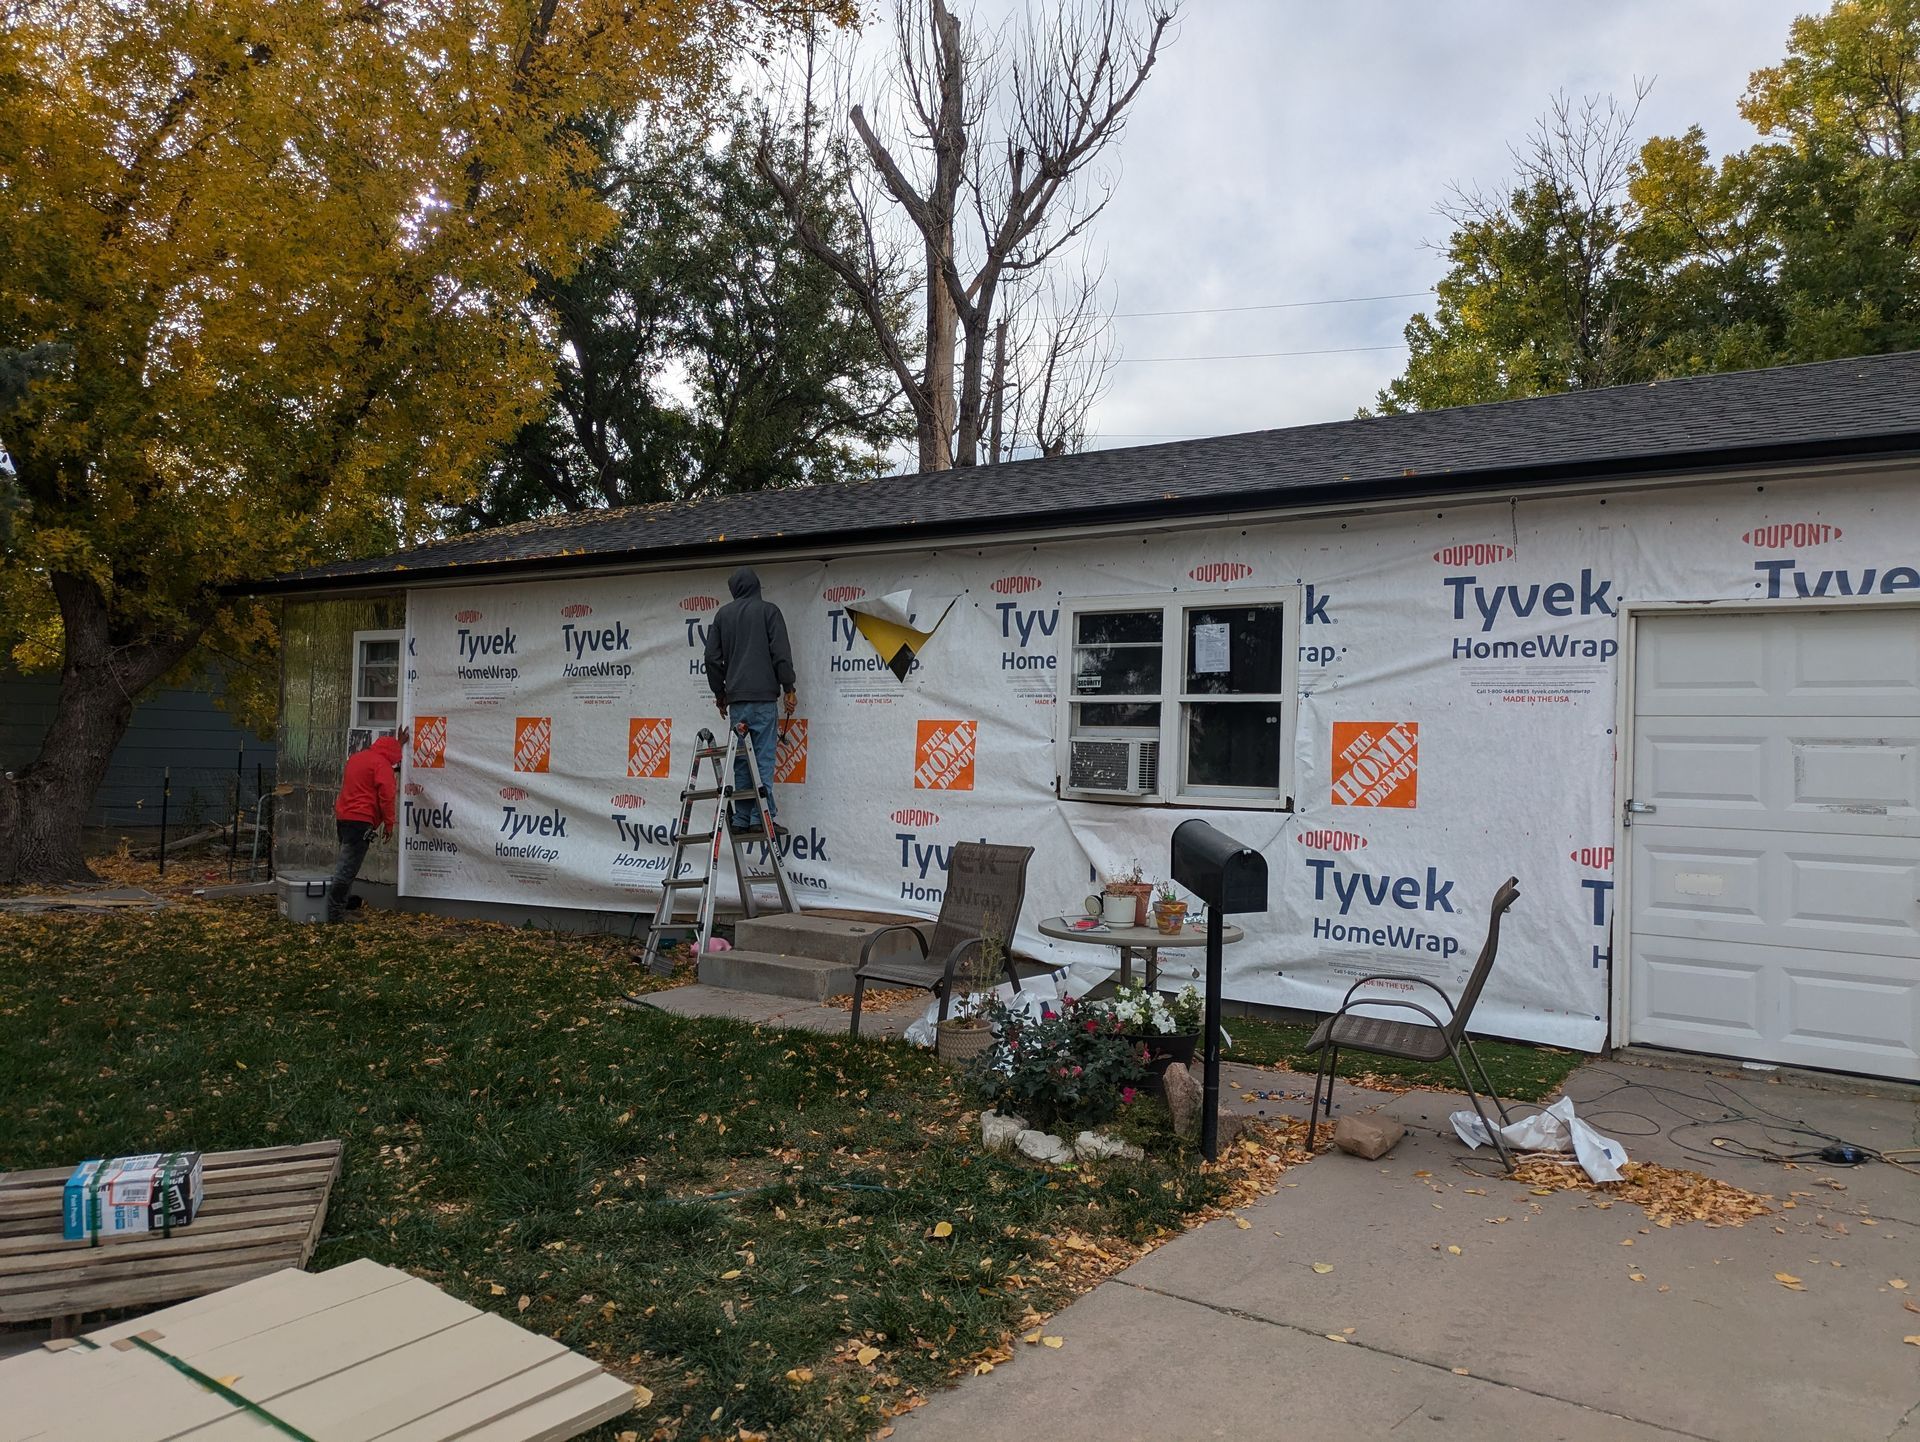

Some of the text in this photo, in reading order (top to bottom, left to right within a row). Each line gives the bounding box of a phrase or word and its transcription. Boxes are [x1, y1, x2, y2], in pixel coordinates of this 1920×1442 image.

[1754, 522, 1832, 549] DUPONT
[1443, 543, 1504, 567] DUPONT
[996, 576, 1036, 594] DUPONT
[1197, 562, 1246, 583] DUPONT
[1754, 559, 1920, 599] Tyve
[684, 596, 715, 612] DUPONT
[827, 586, 862, 603] DUPONT
[1443, 568, 1613, 632] Tyvek
[564, 604, 590, 618] DUPONT
[996, 602, 1059, 647] Tyv
[458, 627, 517, 663] Tyvek
[561, 621, 630, 660] Tyvek
[1452, 634, 1618, 662] HomeWrap
[457, 665, 518, 682] HomeWrap
[562, 661, 632, 679] HomeWrap
[830, 654, 920, 675] HomeWp
[1001, 652, 1057, 670] Home
[1503, 695, 1569, 703] MADE IN THE USA
[413, 717, 447, 768] HOME
[417, 721, 432, 742] THE
[514, 716, 552, 771] HOME
[519, 722, 535, 744] THE
[631, 723, 651, 748] THE
[920, 727, 948, 755] THE
[528, 738, 551, 773] DEPOT
[627, 717, 673, 777] HOME
[643, 740, 671, 778] DEPOT
[774, 720, 809, 773] OME
[914, 720, 977, 790] HOME
[1339, 730, 1376, 765] THE
[936, 746, 975, 790] DEPOT
[1331, 721, 1419, 806] HOME
[502, 787, 528, 801] DUPONT
[1364, 753, 1419, 808] DEPOT
[613, 793, 643, 809] DUPONT
[404, 801, 453, 834] Tyvek
[499, 806, 567, 840] Tyvek
[896, 809, 934, 827] DUPONT
[405, 837, 458, 856] HomeWrap
[495, 842, 559, 863] HomeWrap
[1305, 830, 1360, 851] DUPONT
[1581, 847, 1614, 870] DUP
[1305, 859, 1455, 915] Tyvek
[1313, 917, 1459, 958] HomeWrap
[1376, 980, 1385, 988] IN
[1385, 981, 1400, 990] THE
[1400, 983, 1415, 991] USA
